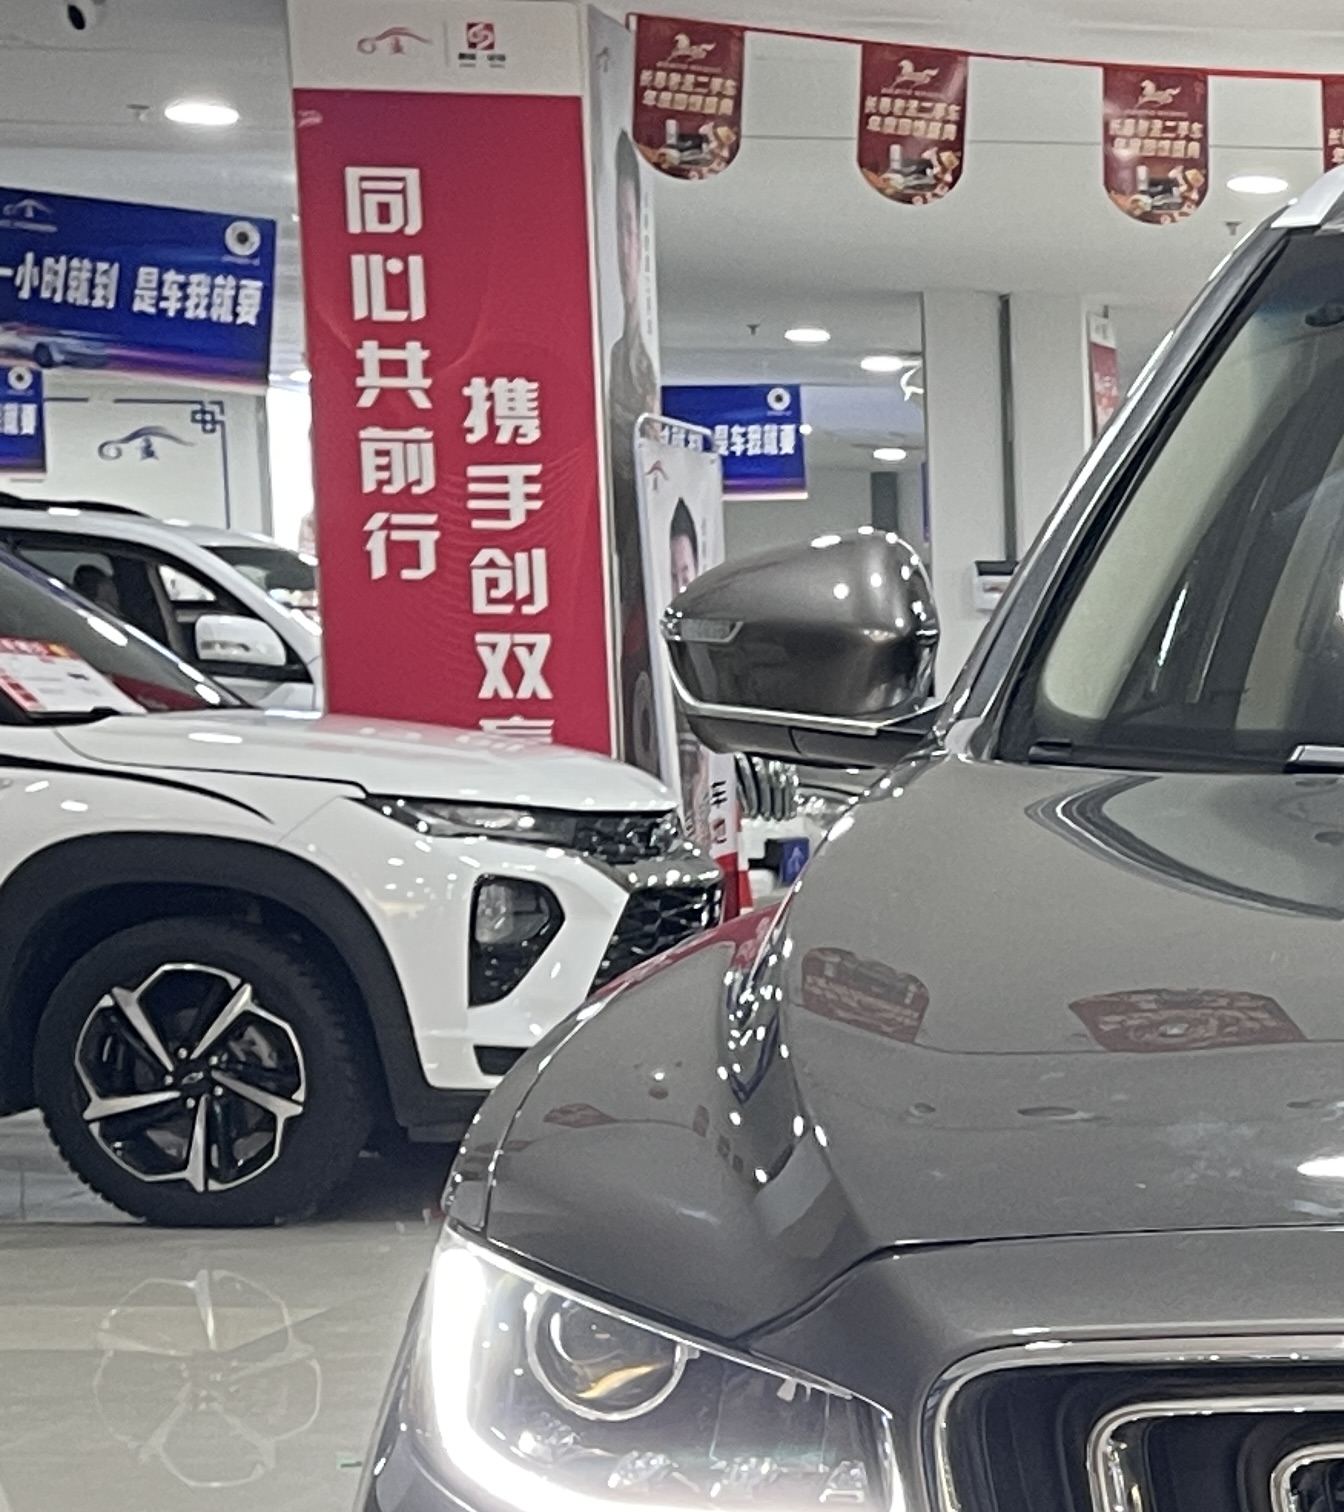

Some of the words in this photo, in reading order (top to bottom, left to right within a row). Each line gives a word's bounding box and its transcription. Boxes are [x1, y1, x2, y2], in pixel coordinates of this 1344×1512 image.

[345, 166, 441, 580] 同心共前行
